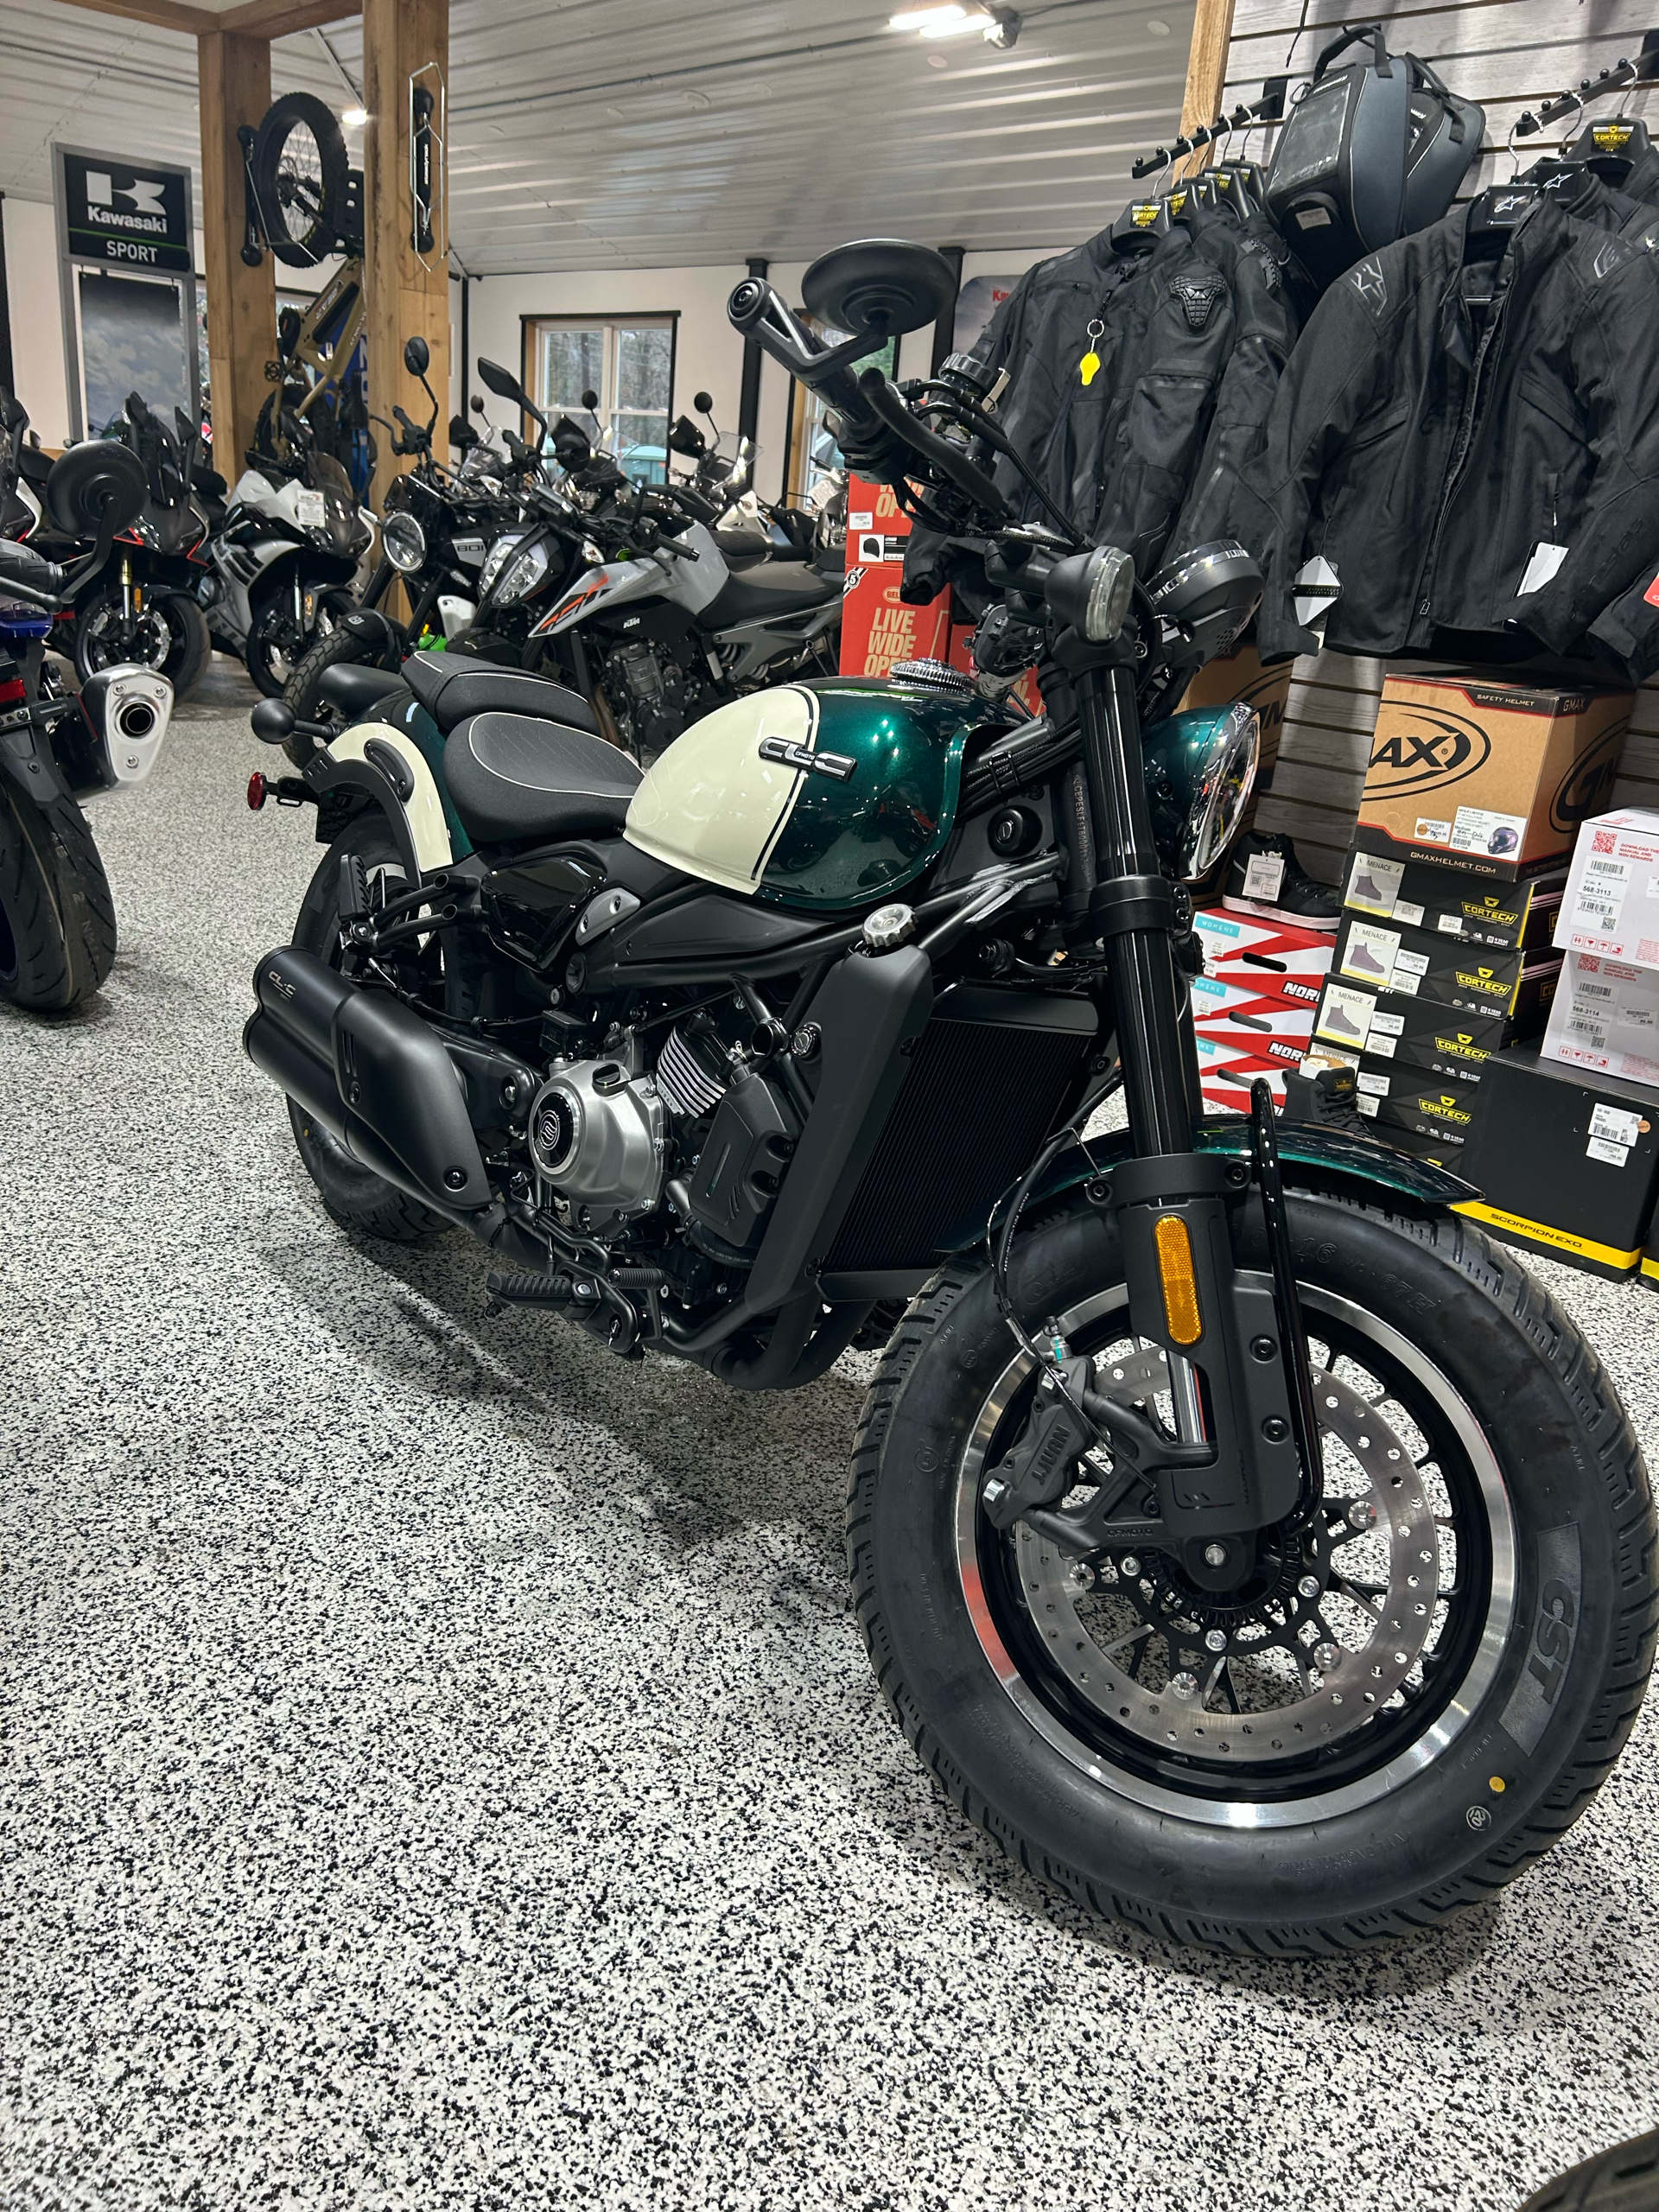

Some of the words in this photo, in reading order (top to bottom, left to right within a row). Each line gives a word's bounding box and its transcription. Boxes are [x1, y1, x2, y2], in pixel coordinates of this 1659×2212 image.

[87, 205, 168, 233] Kawasaki
[106, 239, 158, 263] SPORT
[887, 590, 900, 600] BEL
[623, 617, 640, 629] KTM
[872, 607, 916, 634] LIVE
[868, 631, 917, 658] WIDE
[1477, 694, 1503, 702] SAFETY
[1505, 698, 1535, 707] HELMET
[1563, 697, 1586, 713] GMAX
[795, 751, 816, 760] CFMOTO
[1621, 842, 1649, 852] DOWNLOAD
[1410, 851, 1497, 874] GMAXHELMET.COM
[1630, 854, 1654, 862] REWARDS
[1366, 860, 1392, 873] MENACE
[1583, 885, 1611, 897] 568-3113
[1463, 904, 1515, 922] CORTECH
[1202, 919, 1234, 934] WOMENS
[1362, 929, 1388, 942] MENACE
[1605, 963, 1633, 972] DOWNLOAD
[1458, 974, 1508, 994] CORTECH
[1614, 973, 1637, 982] REWARDS
[1338, 991, 1363, 1004] MENACE
[1572, 1005, 1600, 1017] 568-3114
[1437, 1039, 1488, 1059] CORTECH
[1420, 1100, 1471, 1122] CORTECH
[1491, 1212, 1554, 1239] SCORPION
[1555, 1236, 1583, 1249] EXO
[1107, 1528, 1154, 1538] CFMOTO
[1528, 1577, 1575, 1706] CST
